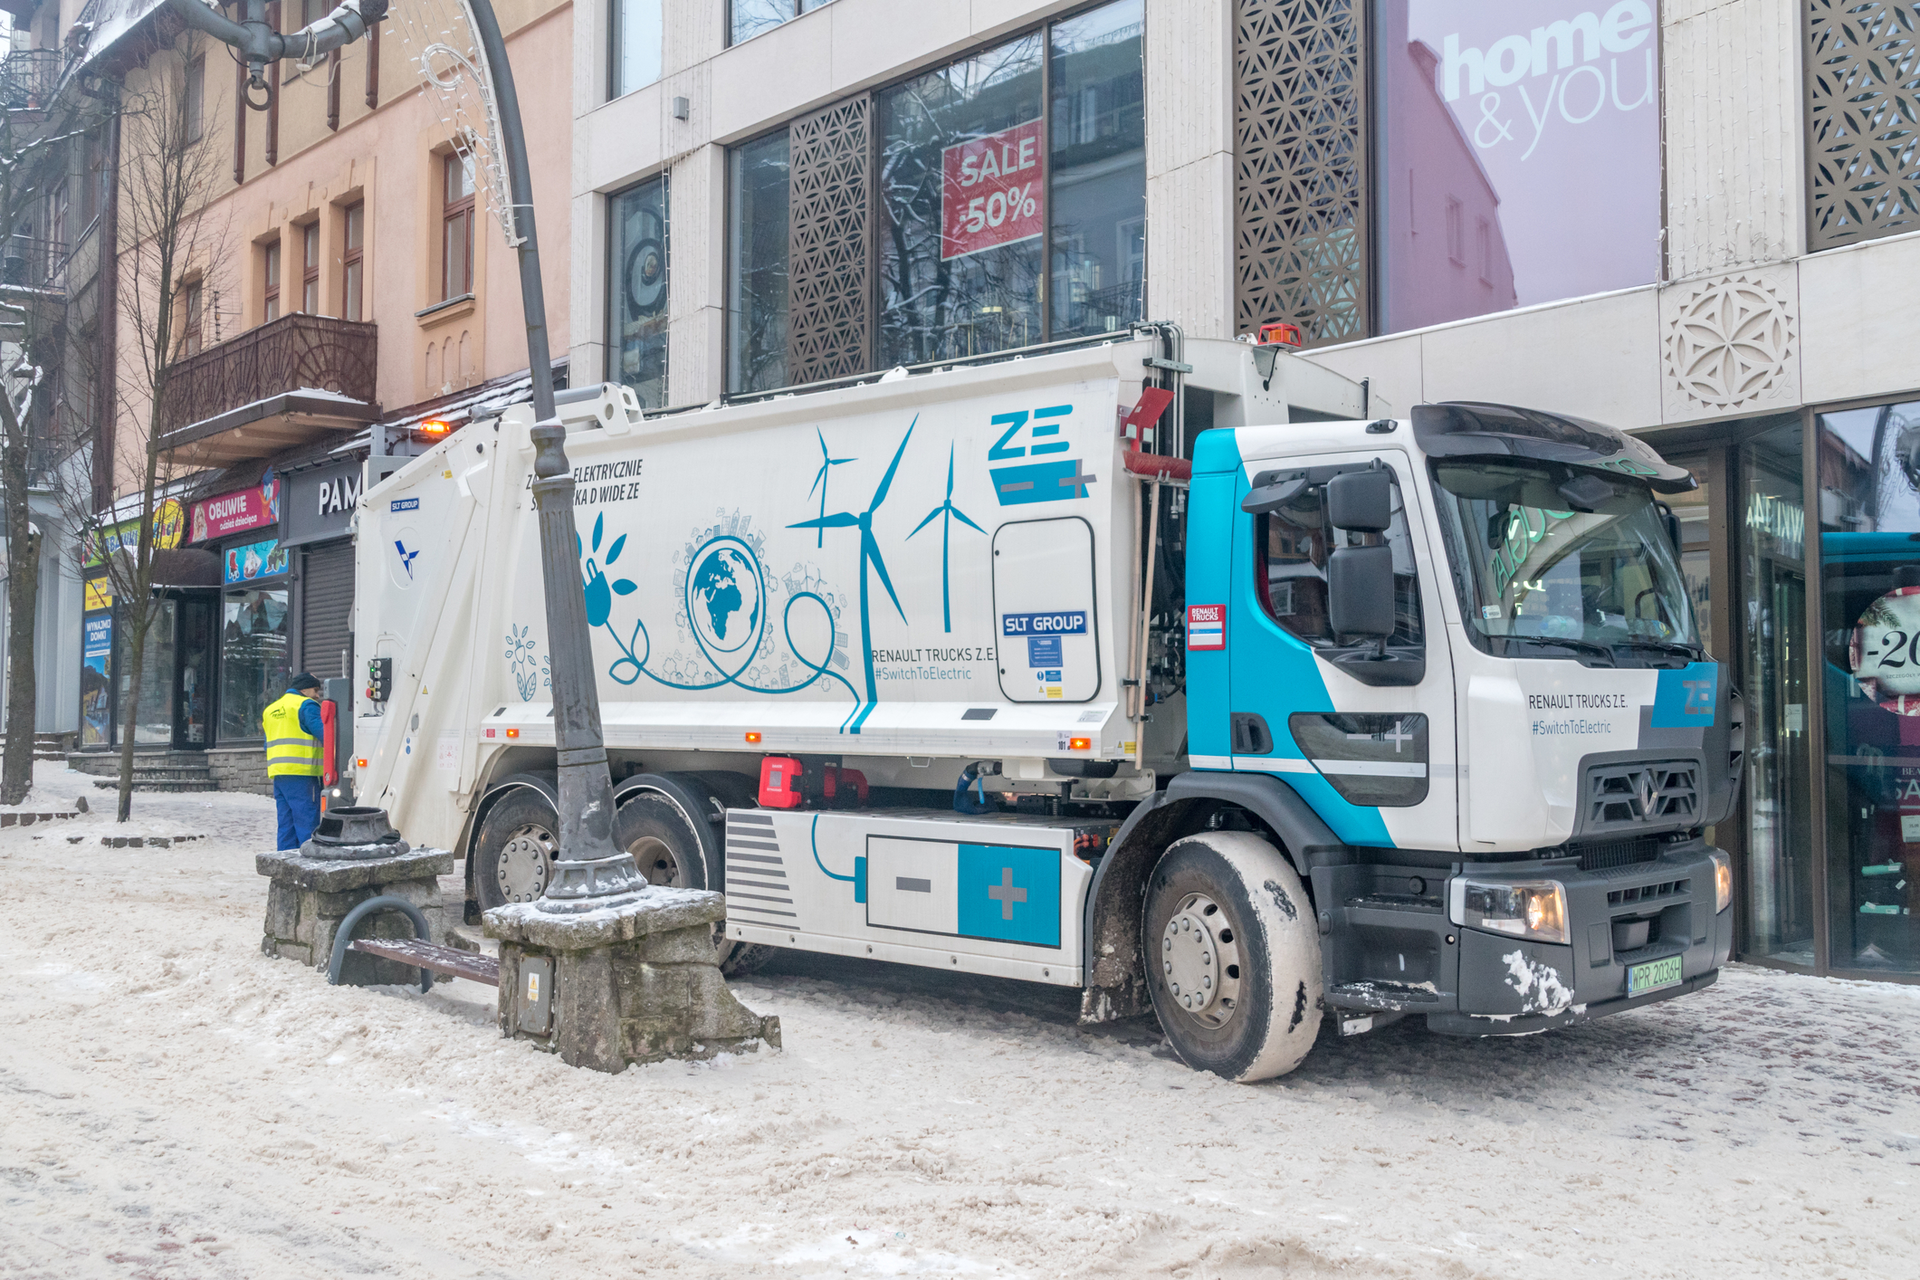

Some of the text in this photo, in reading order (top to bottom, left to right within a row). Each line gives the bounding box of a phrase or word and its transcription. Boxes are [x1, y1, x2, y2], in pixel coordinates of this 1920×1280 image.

[1444, 0, 1652, 102] home
[1474, 48, 1653, 161] & you
[961, 136, 1036, 187] SALE
[959, 182, 1036, 233] -50%
[988, 404, 1073, 461] ZE
[573, 459, 643, 483] ELEKTRYCZNIE
[401, 500, 418, 509] GROUP
[590, 487, 597, 504] D
[600, 484, 626, 503] WIDE
[627, 482, 640, 500] ZE
[208, 495, 247, 521] OBUWIE
[1192, 607, 1219, 616] RENAULT
[1005, 615, 1083, 632] SLT GROUP
[90, 630, 107, 642] DOMKI
[872, 647, 998, 662] RENAULT TRUCKS Z.E.
[875, 666, 972, 680] #SwitchToElectric
[1529, 694, 1628, 709] RENAULT TRUCKS Z.E.
[1682, 680, 1714, 714] ZE
[1532, 719, 1611, 735] #SwitchToElectric
[1632, 958, 1680, 990] WPR 2036H
